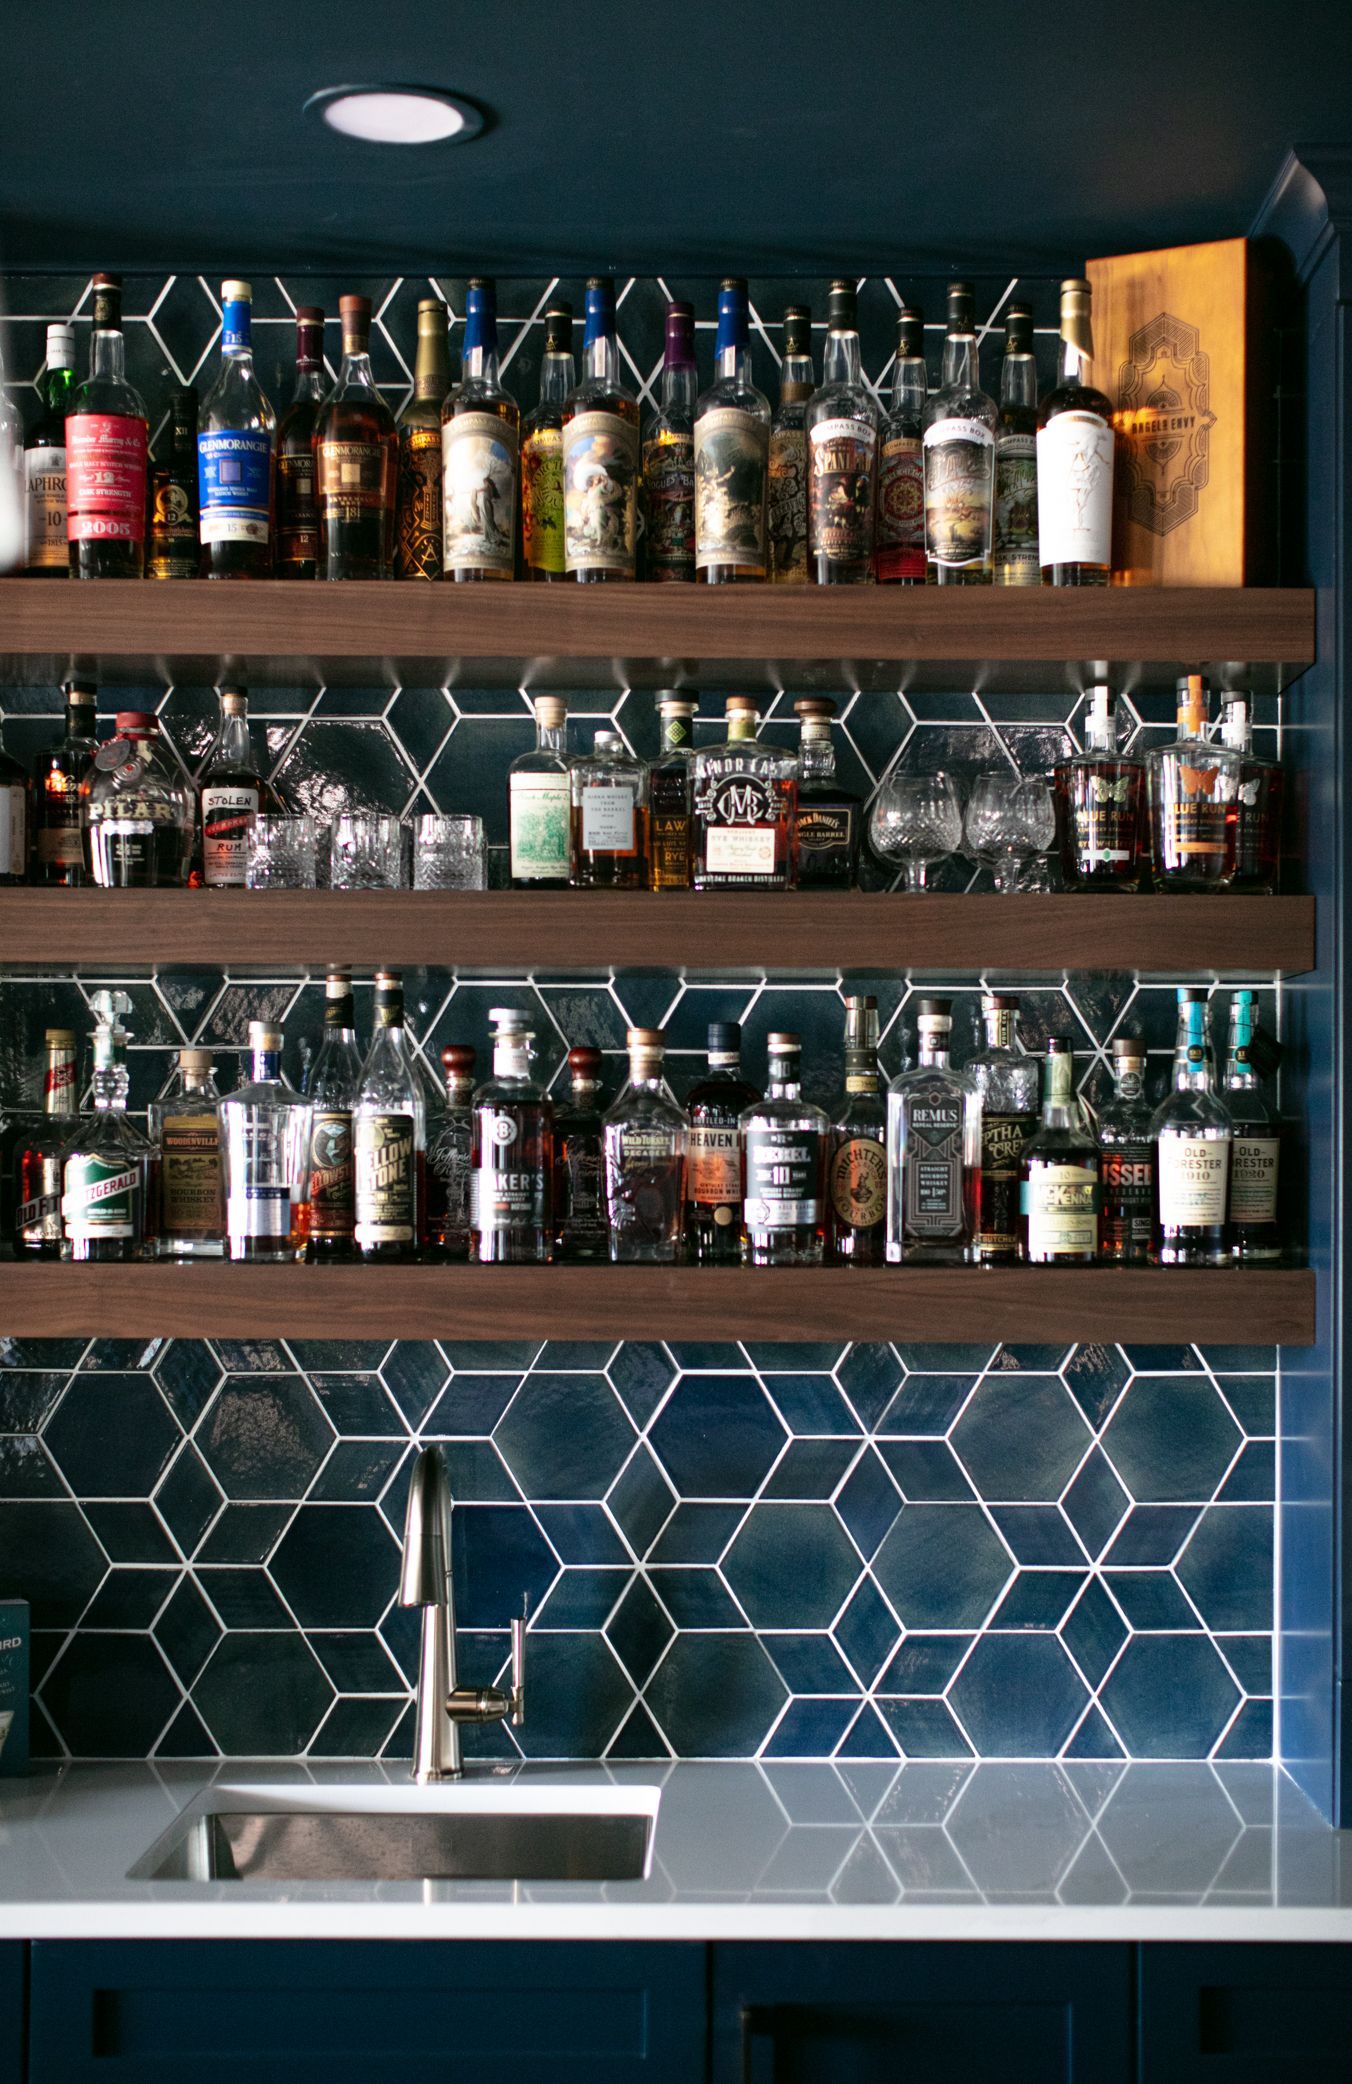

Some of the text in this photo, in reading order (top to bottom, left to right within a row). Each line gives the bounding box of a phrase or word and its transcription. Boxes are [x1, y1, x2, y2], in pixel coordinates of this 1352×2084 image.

[1171, 416, 1195, 430] ENVY
[857, 426, 871, 437] BOX
[969, 427, 985, 439] BOX
[200, 439, 268, 454] GLENMORANGIE
[322, 445, 384, 460] GLENMORANGIE
[96, 488, 132, 498] STRENGTH
[82, 521, 130, 535] 2005
[300, 534, 309, 543] 12
[208, 796, 252, 806] STOLEN
[88, 800, 173, 821] PILAR
[1167, 802, 1226, 814] LUE RUN
[1077, 810, 1134, 821] UE RUN
[656, 820, 686, 832] LAW
[217, 844, 241, 852] RUM
[664, 852, 685, 860] RYE
[913, 1109, 957, 1122] REMUS
[621, 1135, 641, 1146] WILD
[691, 1133, 733, 1147] HEAVEN
[1184, 1147, 1207, 1157] OLD
[1239, 1146, 1261, 1156] OLD
[1170, 1160, 1222, 1169] ORESTER
[1183, 1171, 1210, 1180] 910
[1233, 1170, 1265, 1179] 1920
[170, 1188, 217, 1196] BOURBON
